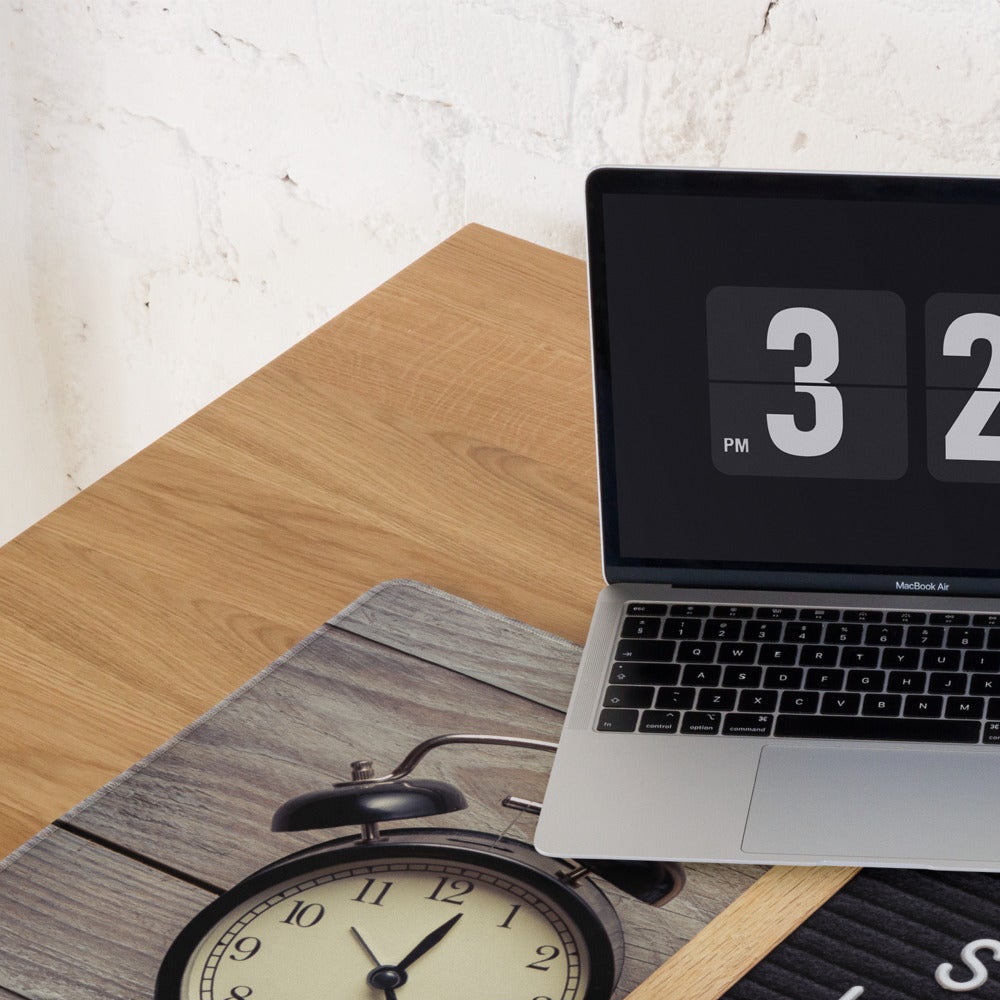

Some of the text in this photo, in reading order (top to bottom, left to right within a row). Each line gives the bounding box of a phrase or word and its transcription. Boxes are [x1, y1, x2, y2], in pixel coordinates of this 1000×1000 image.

[765, 306, 844, 457] 3
[722, 437, 750, 454] PM
[895, 581, 950, 591] MacBook Air
[717, 629, 726, 638] 2
[757, 630, 766, 639] 3
[798, 632, 807, 640] 4
[839, 633, 847, 642] 5
[879, 635, 888, 643] 6
[921, 636, 929, 644] 7
[960, 637, 969, 646] 8
[692, 648, 702, 656] Q
[731, 649, 744, 657] W
[773, 650, 782, 658] E
[814, 651, 824, 660] R
[856, 653, 864, 661] T
[896, 654, 905, 663] Y
[936, 656, 947, 664] U
[696, 671, 706, 679] A
[738, 672, 747, 681] S
[778, 673, 788, 682] D
[820, 675, 829, 683] F
[860, 676, 870, 685] G
[901, 678, 912, 686] H
[944, 679, 952, 688] J
[984, 680, 993, 689] K
[712, 695, 722, 704] Z
[753, 696, 763, 705] X
[794, 697, 804, 706] C
[836, 699, 846, 708] V
[877, 700, 886, 709] B
[918, 702, 928, 710] N
[959, 703, 971, 711] M
[688, 724, 714, 732] option
[350, 878, 394, 907] 11
[424, 877, 475, 906] 12
[279, 900, 326, 928] 10
[497, 904, 522, 929] 1
[228, 936, 261, 962] 9
[526, 944, 560, 972] 2
